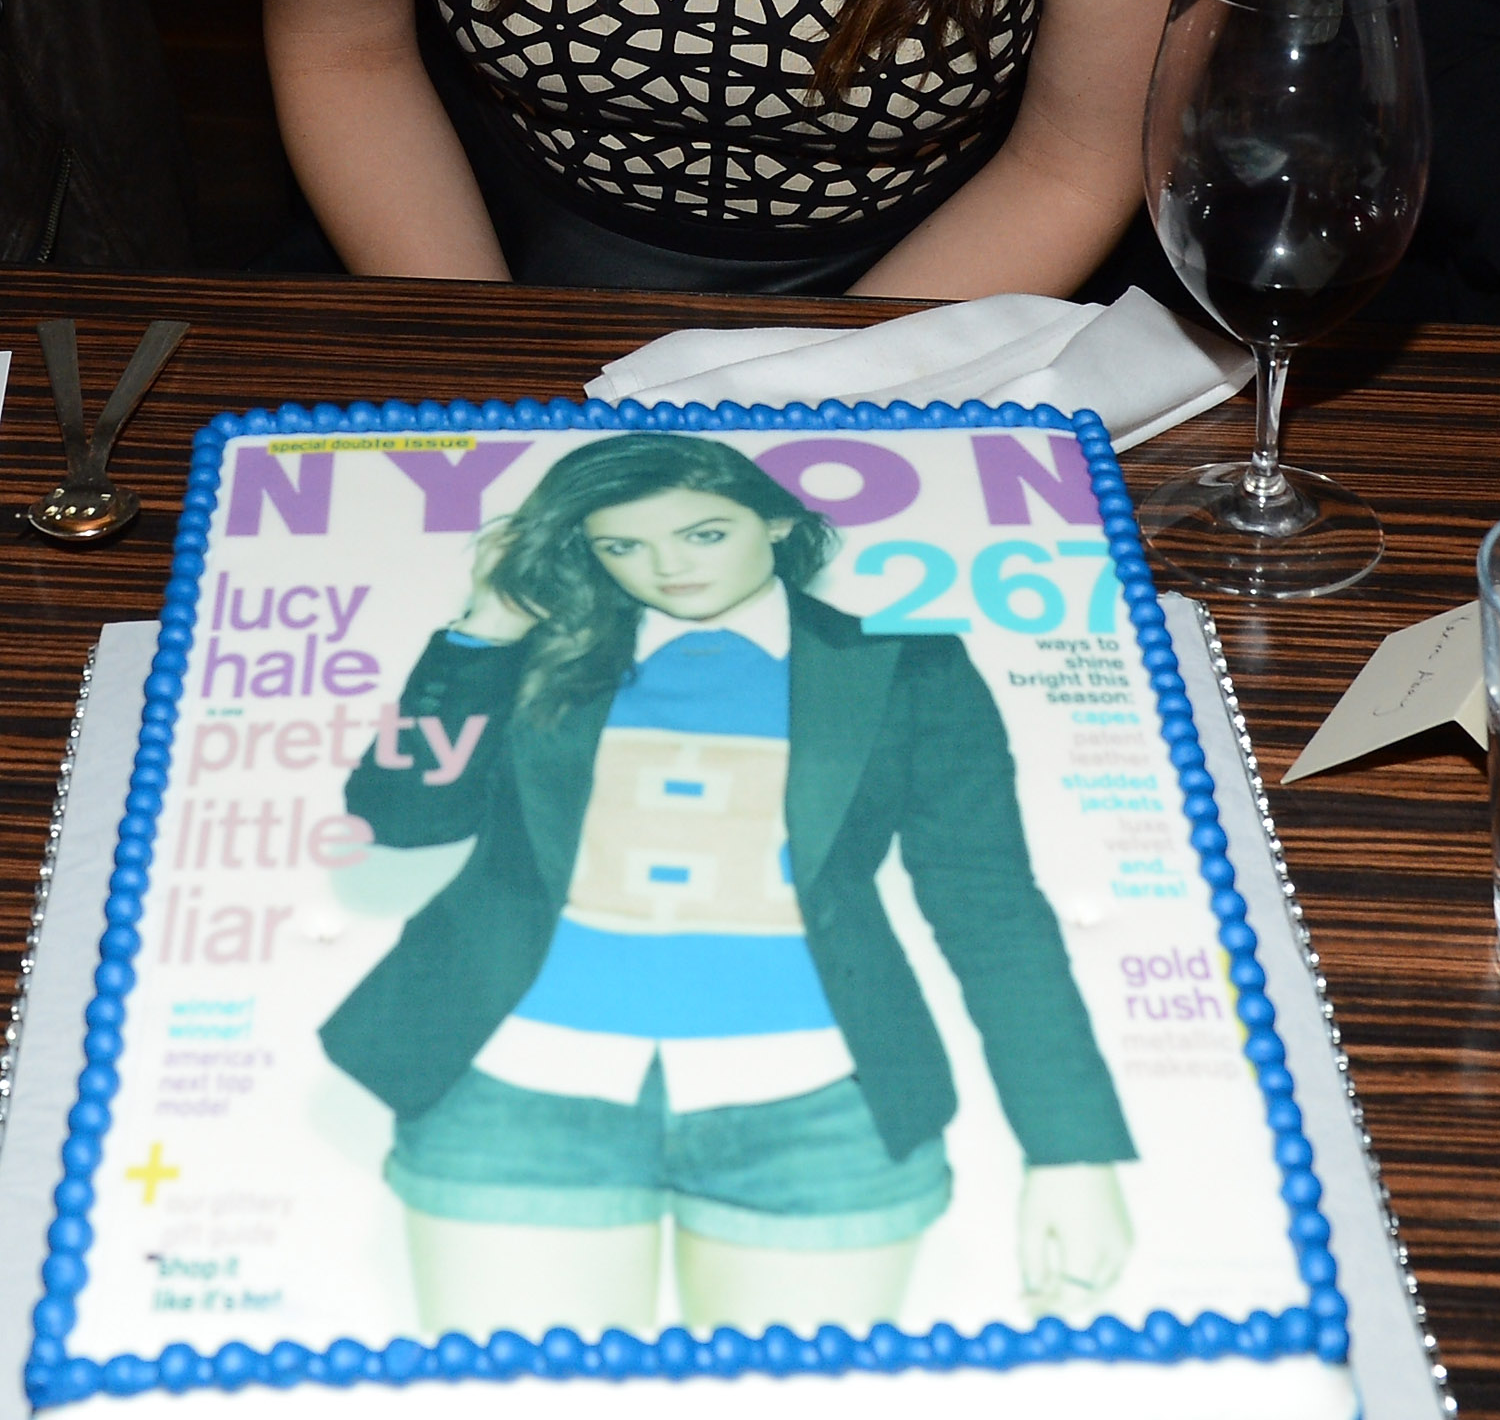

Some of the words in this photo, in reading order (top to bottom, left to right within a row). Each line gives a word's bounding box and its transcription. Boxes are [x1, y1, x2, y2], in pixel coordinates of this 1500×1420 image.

[271, 439, 326, 453] special
[331, 438, 395, 450] double
[404, 437, 469, 449] issue
[225, 435, 1103, 537] NYON
[854, 540, 1120, 635] 267
[211, 571, 371, 642] lucy
[1036, 638, 1090, 653] ways
[1097, 637, 1119, 651] to
[1065, 656, 1124, 670] shine
[200, 634, 382, 698] hale
[1008, 671, 1082, 688] bright
[1090, 671, 1129, 687] this
[1071, 709, 1140, 726] capes
[187, 703, 489, 786] pretty
[1061, 773, 1158, 791] studded
[1080, 794, 1164, 813] jackets
[173, 797, 375, 871] little
[157, 885, 293, 965] liar
[1121, 946, 1211, 987] gold
[1126, 987, 1223, 1020] rush
